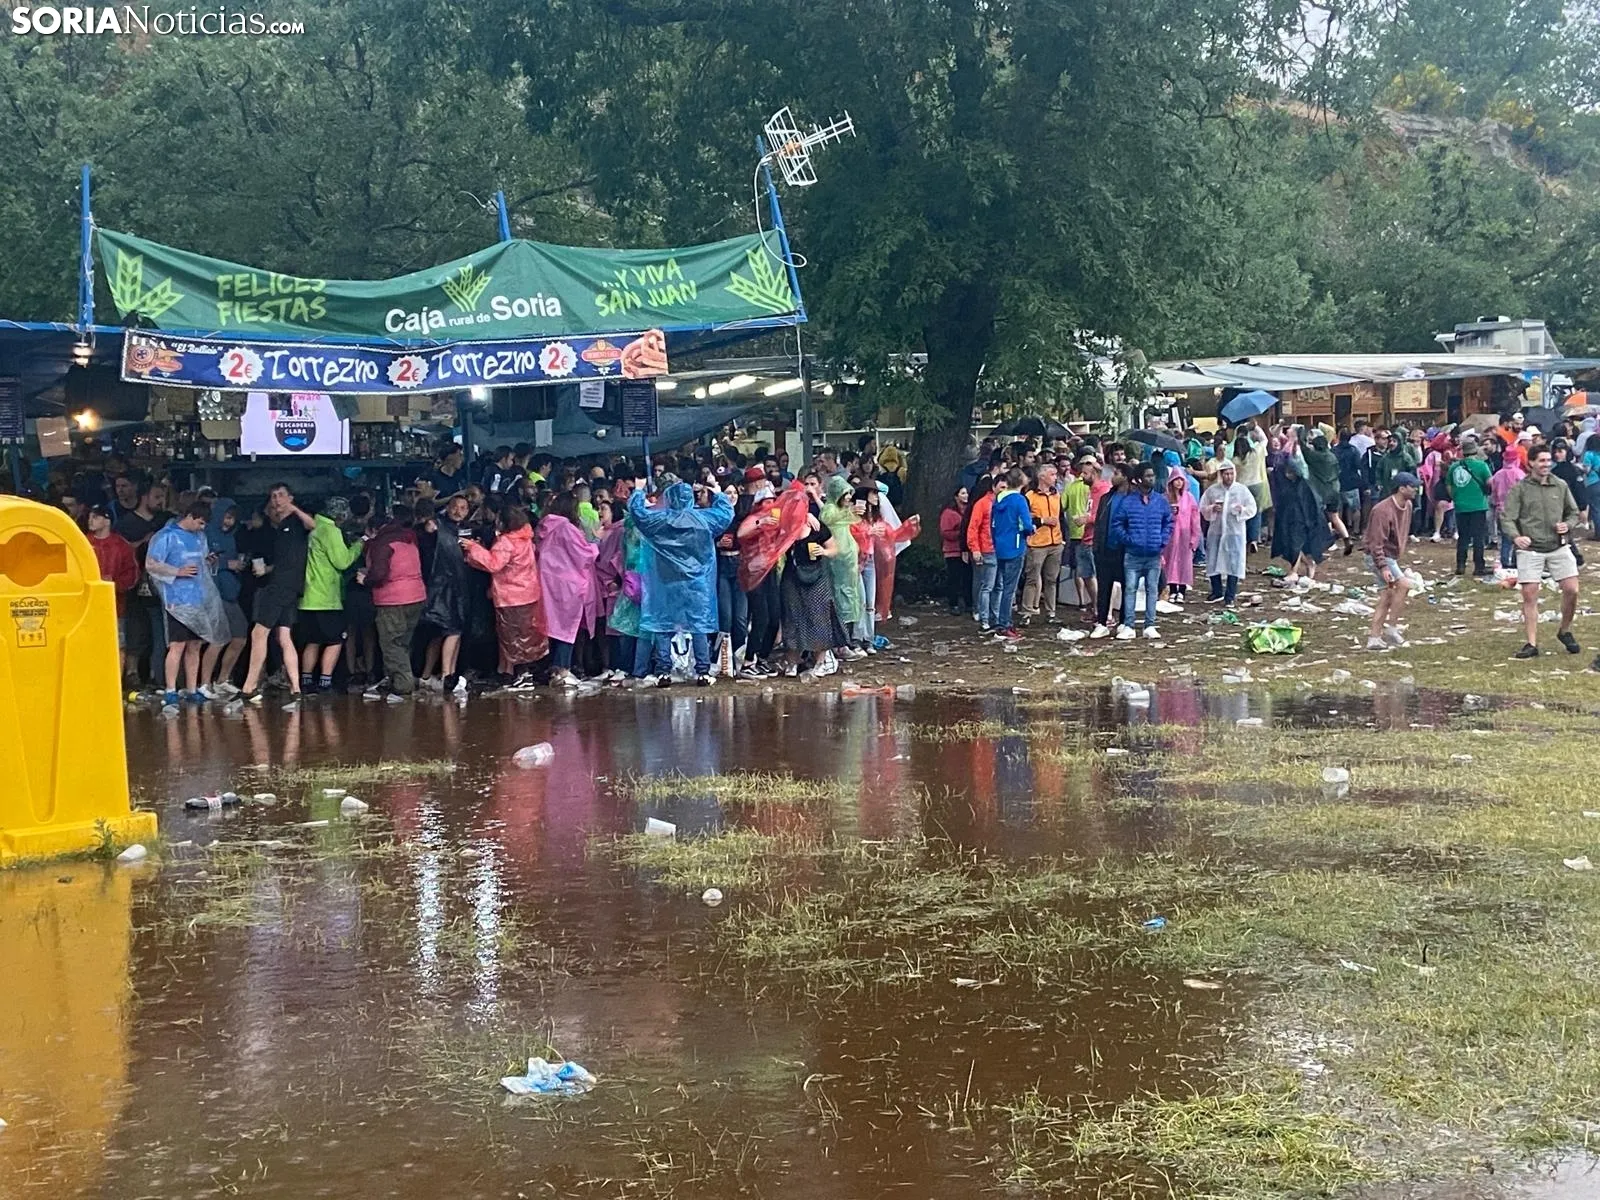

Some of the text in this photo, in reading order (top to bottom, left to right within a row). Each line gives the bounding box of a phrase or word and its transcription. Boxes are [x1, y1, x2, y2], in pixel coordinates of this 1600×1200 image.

[216, 272, 326, 298] FELICES
[631, 258, 684, 286] VIVA
[216, 296, 326, 327] FIESTAS
[385, 292, 562, 335] Caja rural de Soria
[594, 279, 698, 317] SAN JUAN
[263, 350, 379, 386] Torrezno
[431, 350, 536, 381] Torrezno
